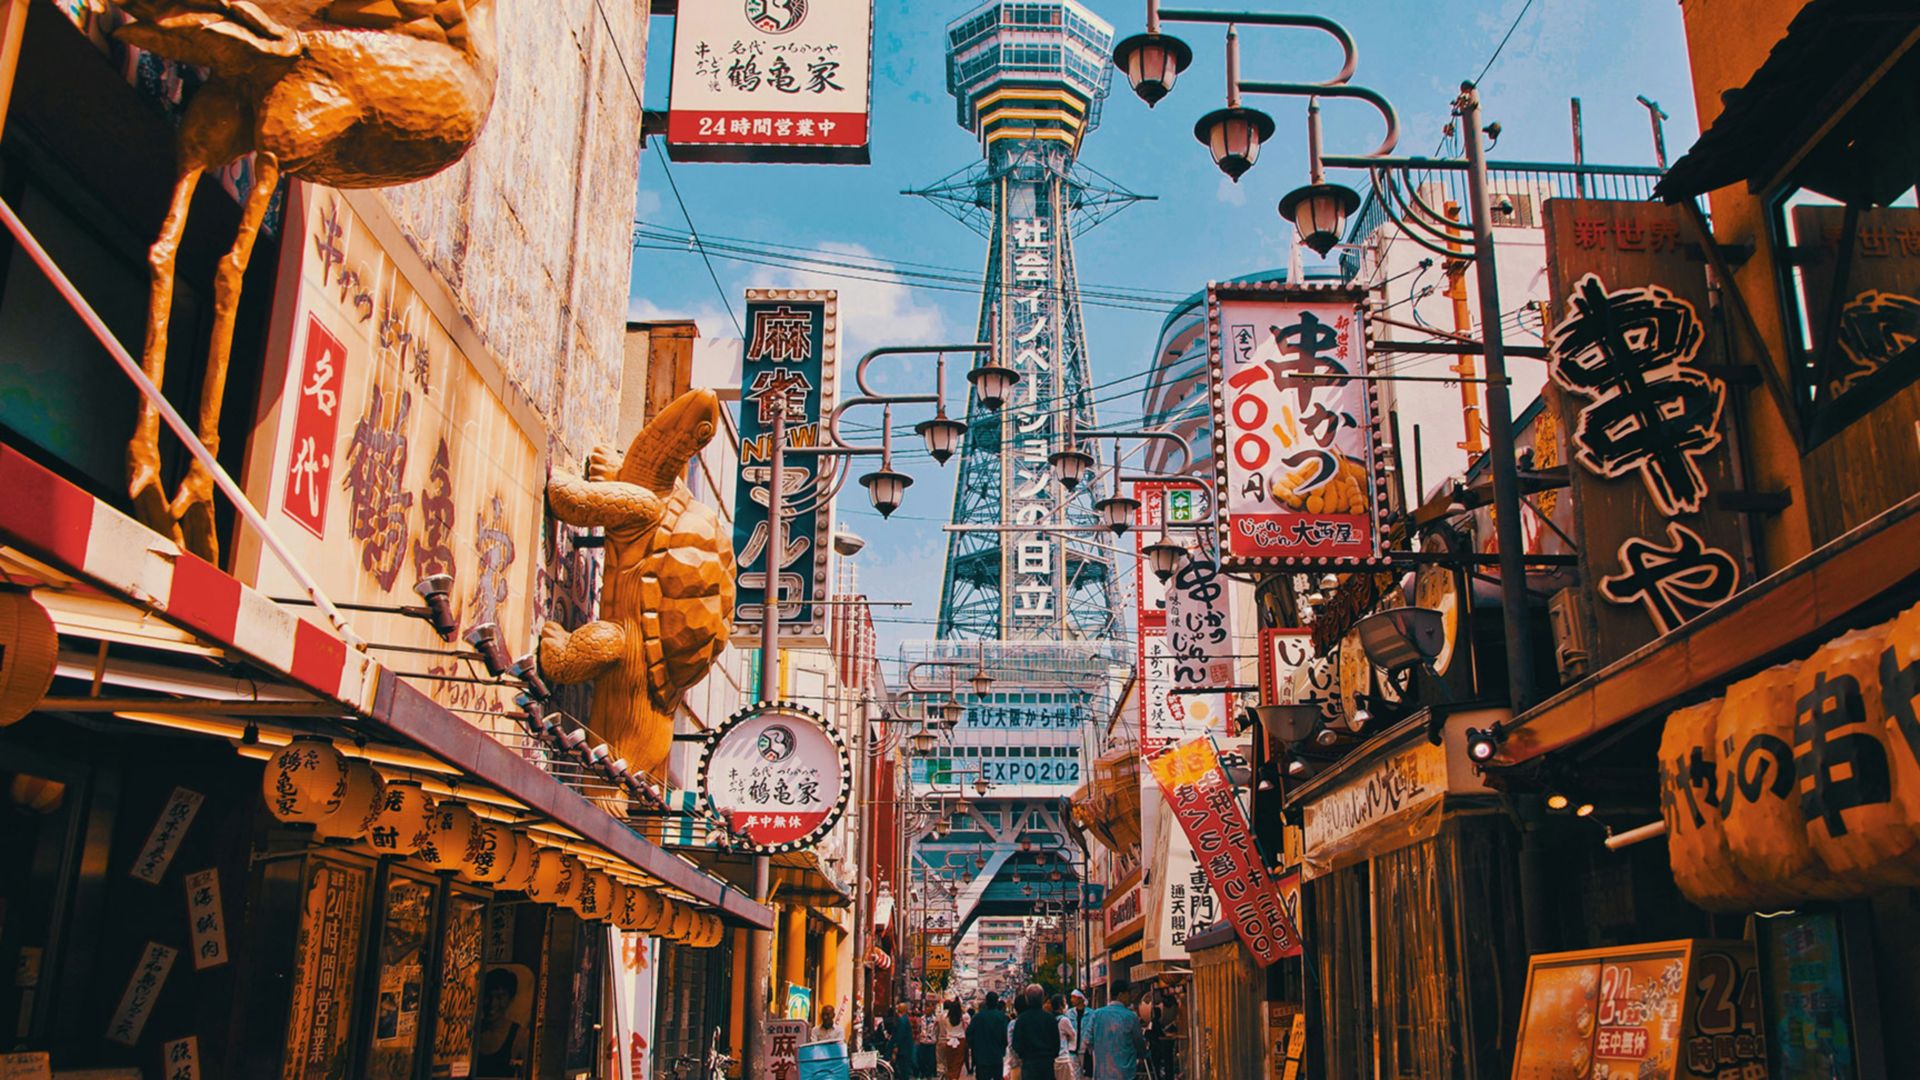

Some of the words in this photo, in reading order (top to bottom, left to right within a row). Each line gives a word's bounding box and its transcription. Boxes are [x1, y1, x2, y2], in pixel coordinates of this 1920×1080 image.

[727, 54, 845, 94] 鶴亀家
[699, 117, 837, 137] 24時間営業中
[1573, 218, 1681, 251] 新世界
[744, 306, 813, 424] 麻雀
[1012, 219, 1055, 617] 社会イノベーションの日立
[1265, 311, 1358, 492] 串かつ
[291, 348, 335, 518] 名代
[737, 466, 811, 620] マルコ
[275, 749, 303, 815] 鶴亀家
[749, 777, 822, 806] 鶴亀家
[981, 763, 1079, 781] EXPO202
[746, 815, 802, 829] 年中無休
[1171, 884, 1186, 946] 通天閣店
[1598, 1031, 1647, 1056] 年中無休
